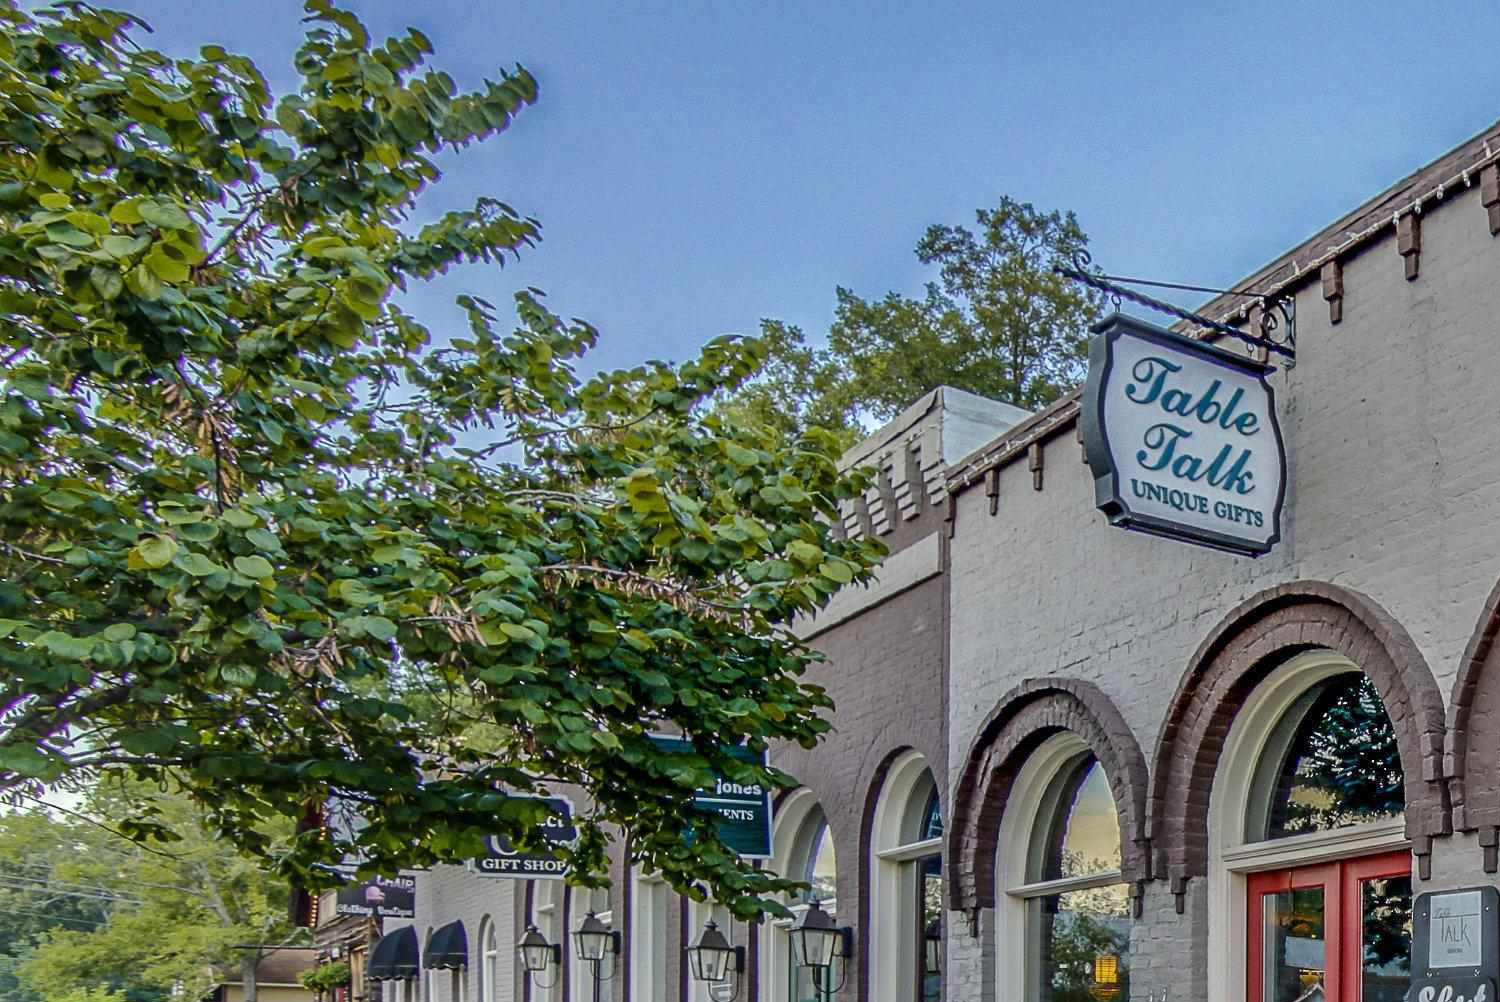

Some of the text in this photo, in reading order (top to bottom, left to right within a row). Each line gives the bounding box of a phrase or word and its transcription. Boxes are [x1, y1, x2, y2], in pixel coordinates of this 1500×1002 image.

[1125, 356, 1260, 436] Table
[1135, 423, 1256, 496] Talk
[1131, 478, 1264, 528] UNIQUE GIFTS
[482, 858, 567, 872] GIFT SHOP
